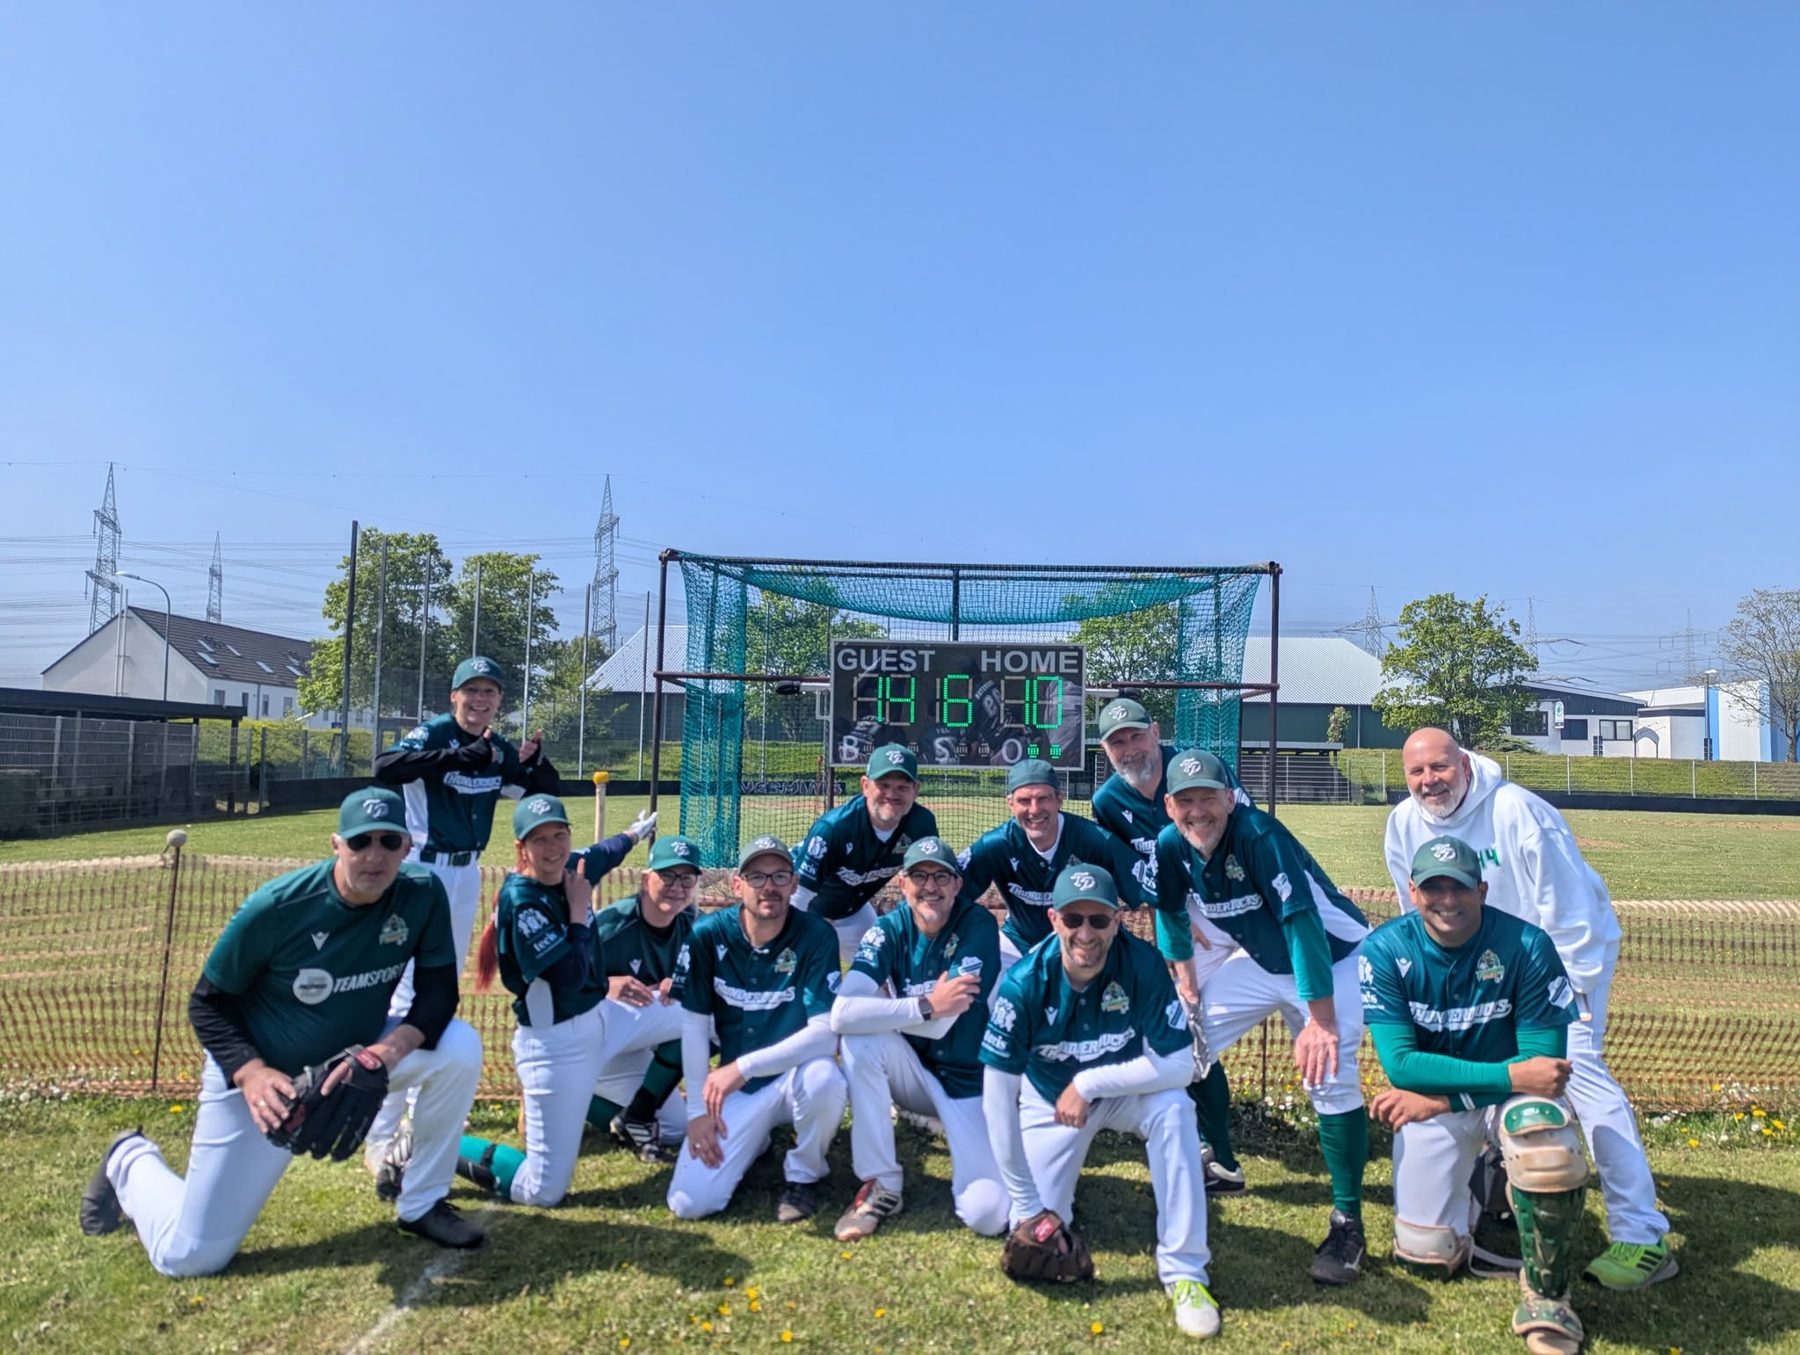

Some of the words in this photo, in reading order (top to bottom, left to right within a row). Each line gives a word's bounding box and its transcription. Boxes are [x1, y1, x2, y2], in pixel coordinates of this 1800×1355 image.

[837, 649, 935, 672] GUEST
[981, 651, 1079, 673] HOME
[877, 676, 916, 724] 14
[943, 674, 973, 727] 6
[1024, 676, 1063, 729] 10
[842, 735, 860, 761] B
[933, 737, 950, 762] S
[1002, 738, 1022, 764] O
